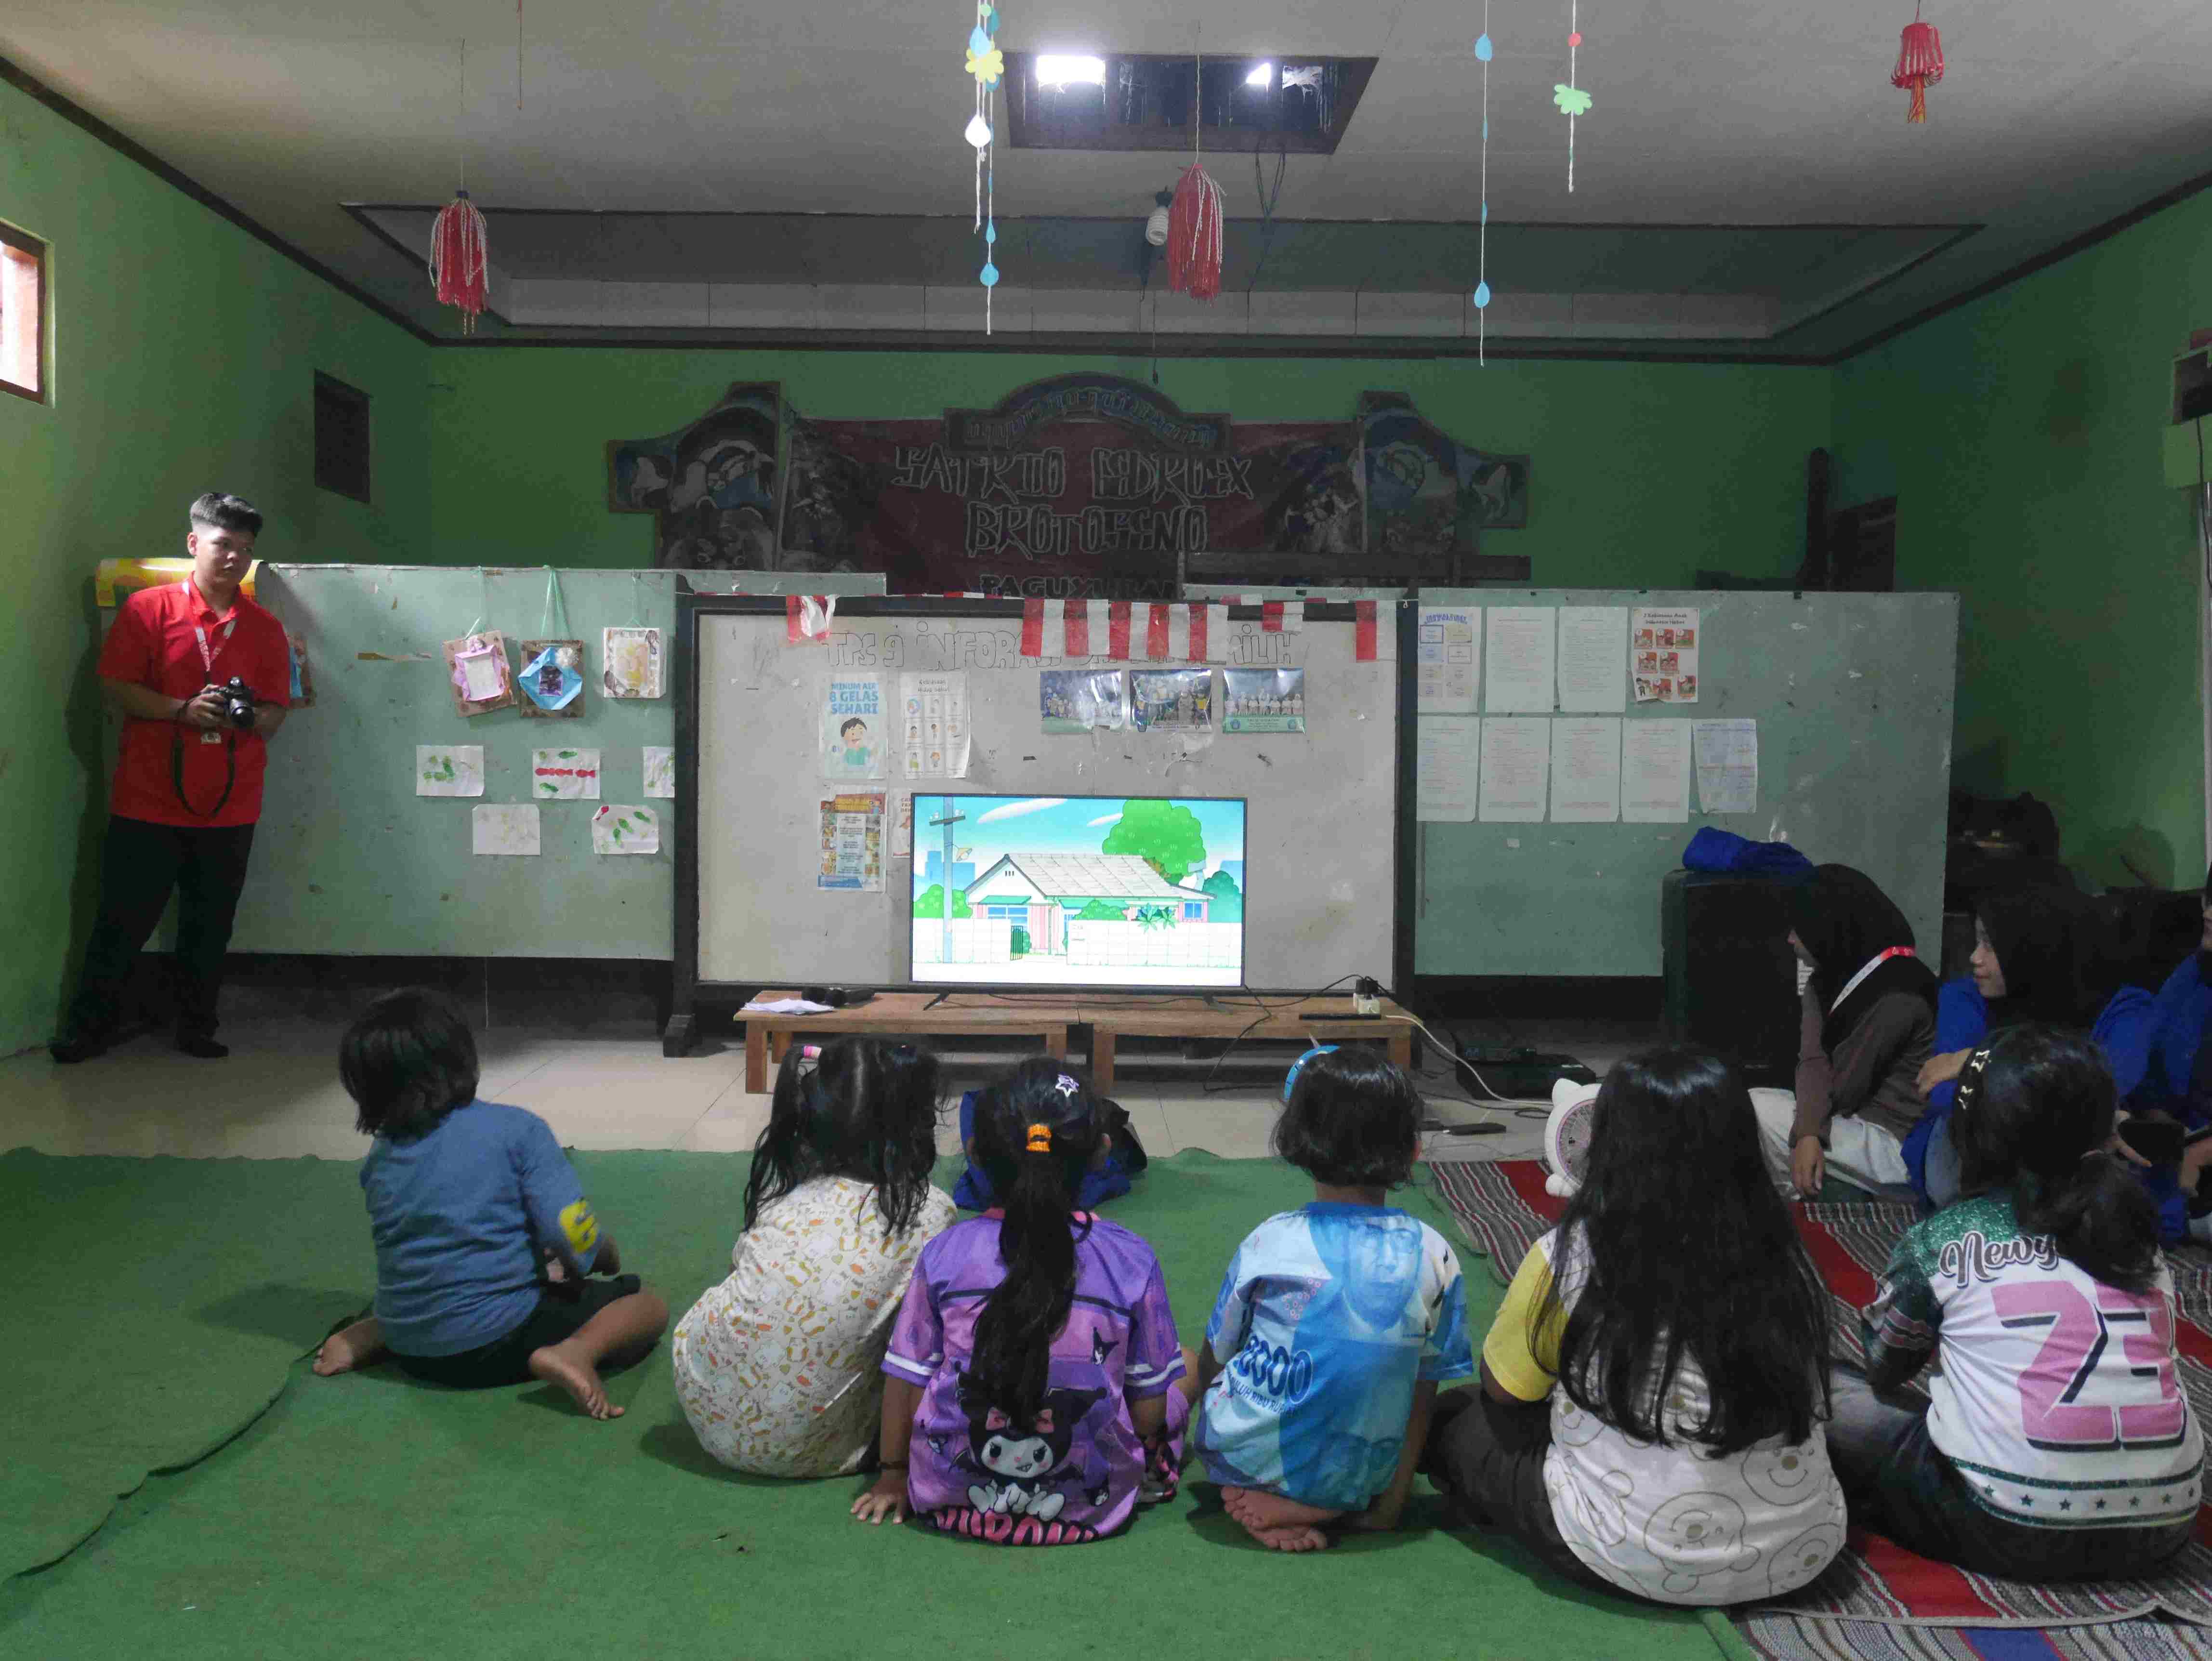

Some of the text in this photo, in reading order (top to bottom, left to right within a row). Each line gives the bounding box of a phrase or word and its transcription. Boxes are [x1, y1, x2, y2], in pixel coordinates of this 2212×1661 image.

[965, 500, 1209, 560] BROTOSENO
[821, 630, 877, 667] TPS
[831, 682, 860, 690] MINUM
[829, 690, 878, 702] 8 GELAS
[831, 703, 878, 714] SEHARI
